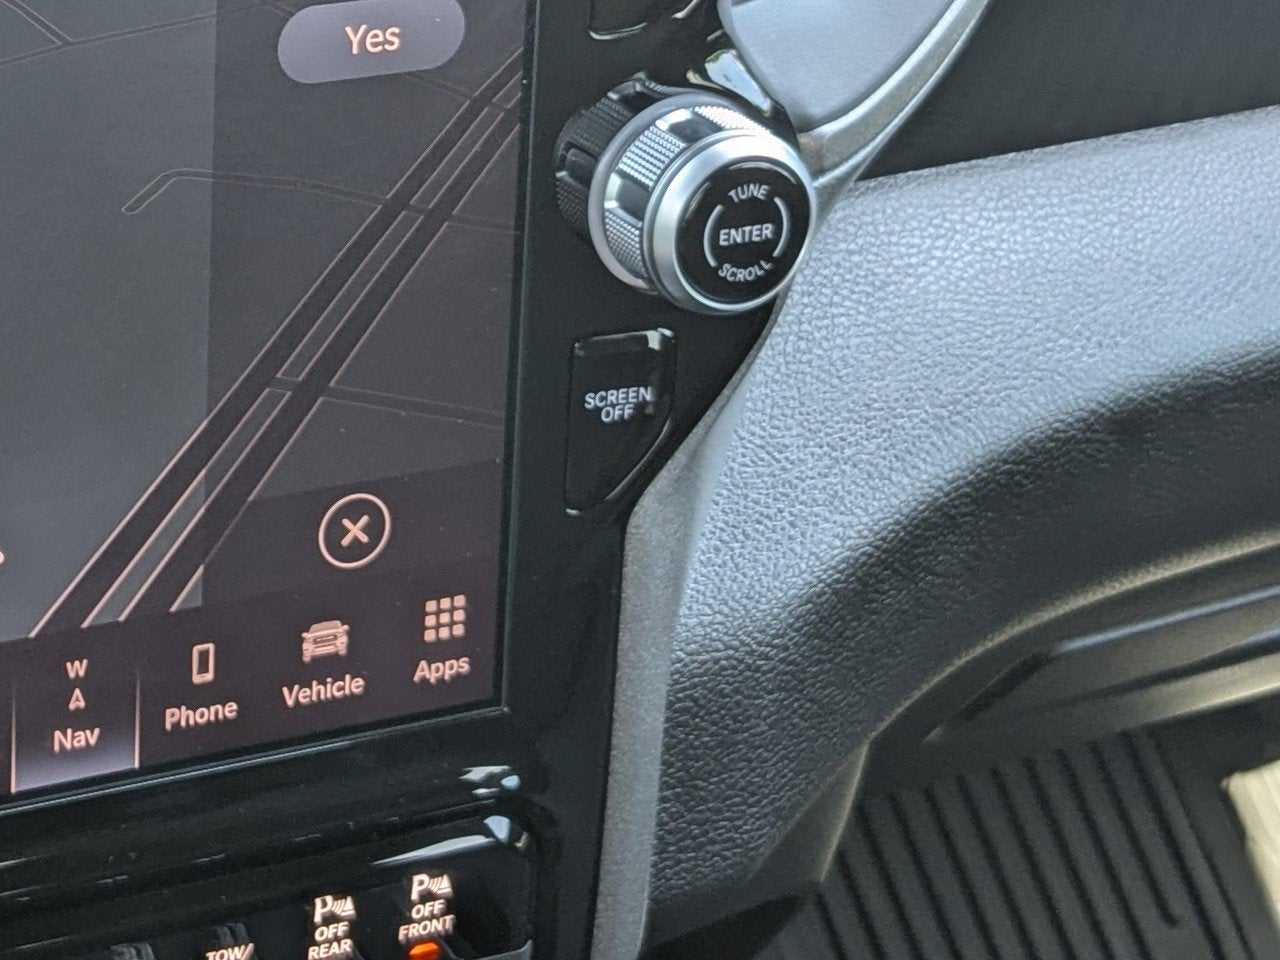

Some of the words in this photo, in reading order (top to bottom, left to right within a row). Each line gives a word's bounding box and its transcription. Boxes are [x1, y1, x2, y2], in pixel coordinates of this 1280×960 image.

[344, 24, 401, 56] Yes
[727, 183, 770, 203] TUNE
[719, 223, 773, 246] ENTER
[718, 259, 774, 283] SCROLL
[584, 386, 653, 411] SCREEN
[600, 404, 634, 424] OFF
[65, 658, 88, 679] W
[413, 655, 471, 686] Apps
[281, 673, 366, 709] Vehicle
[165, 700, 239, 731] Phone
[53, 727, 101, 753] Nav
[411, 899, 446, 920] OFF
[314, 921, 350, 942] OFF
[398, 915, 455, 942] FRONT
[308, 939, 354, 960] REAR
